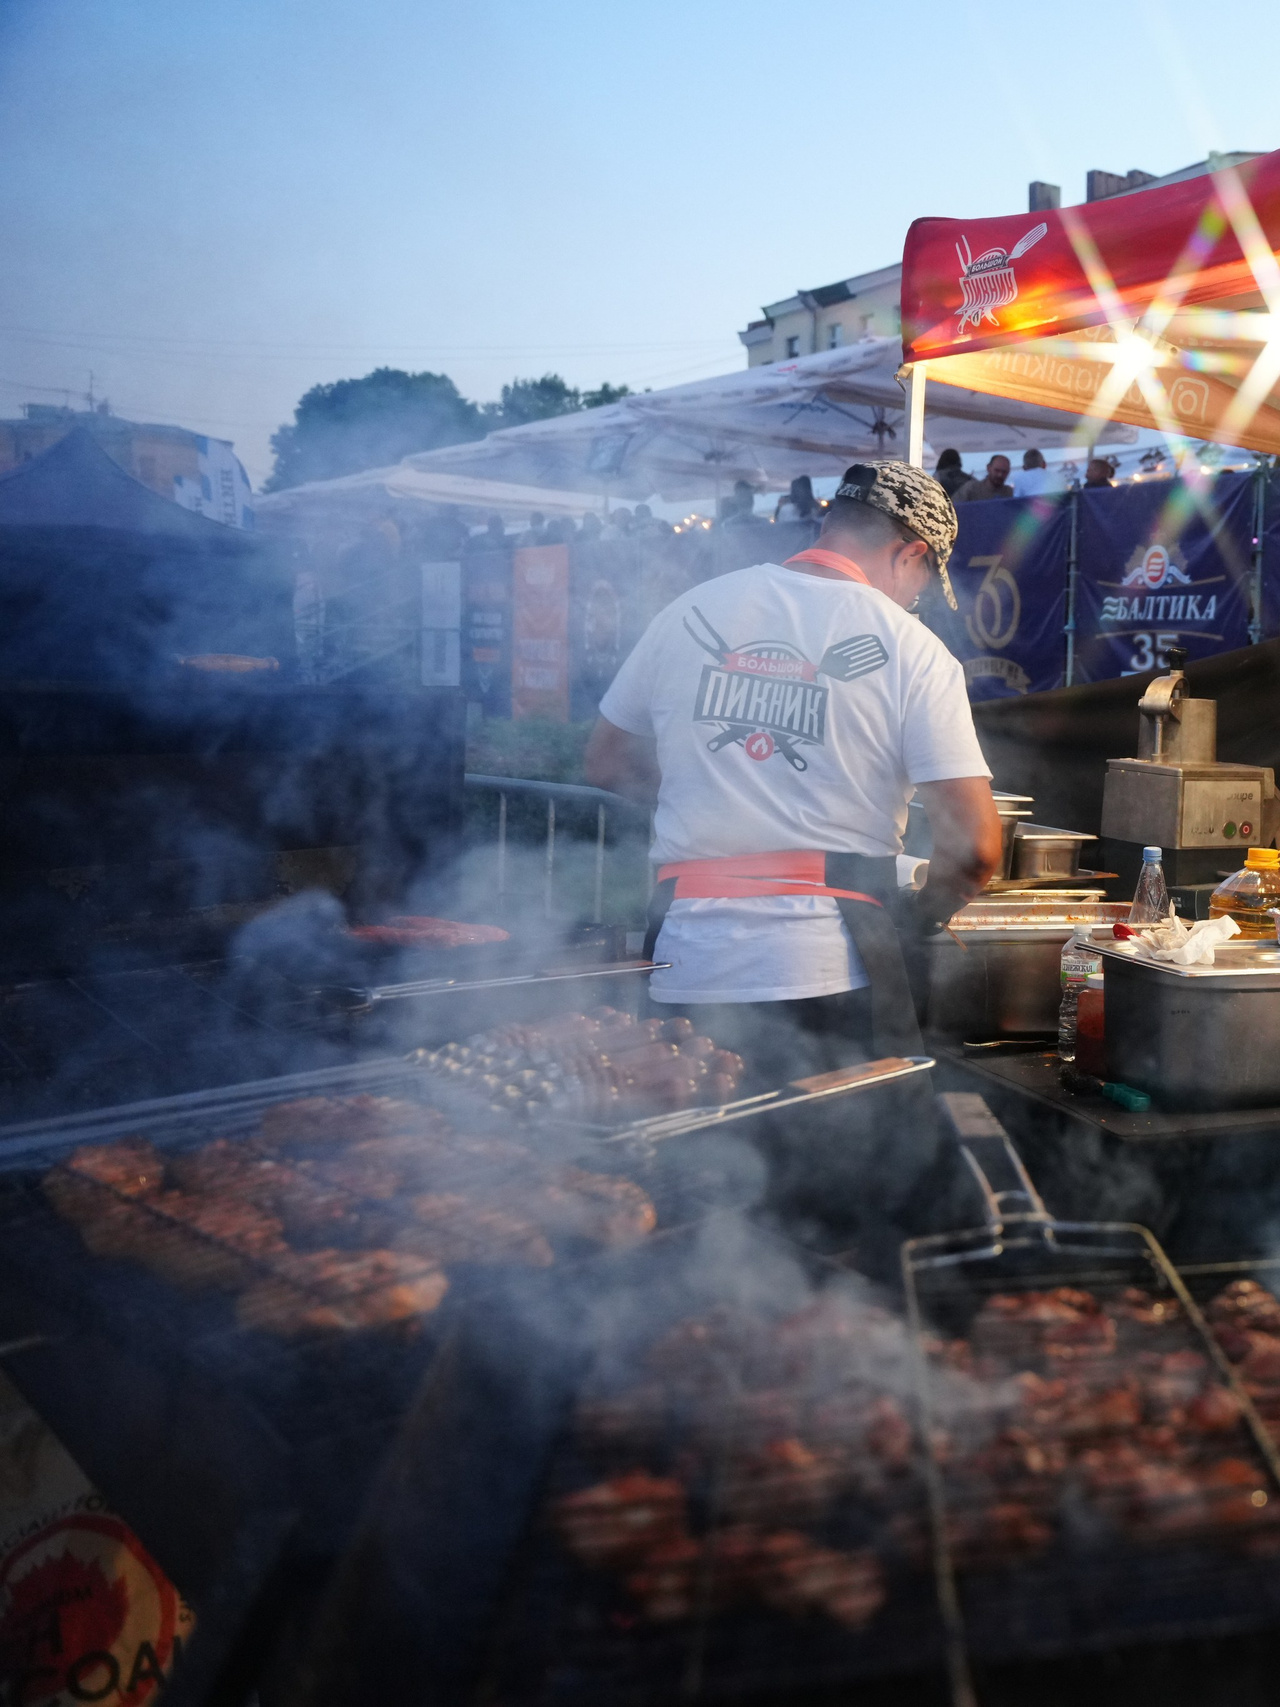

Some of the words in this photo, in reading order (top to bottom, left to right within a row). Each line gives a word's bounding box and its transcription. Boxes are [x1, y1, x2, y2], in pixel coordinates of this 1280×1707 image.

[1115, 594, 1218, 621] БАЛТИКА
[737, 655, 804, 676] БОЛЬШОЙ
[701, 670, 823, 739] ПИКНИК
